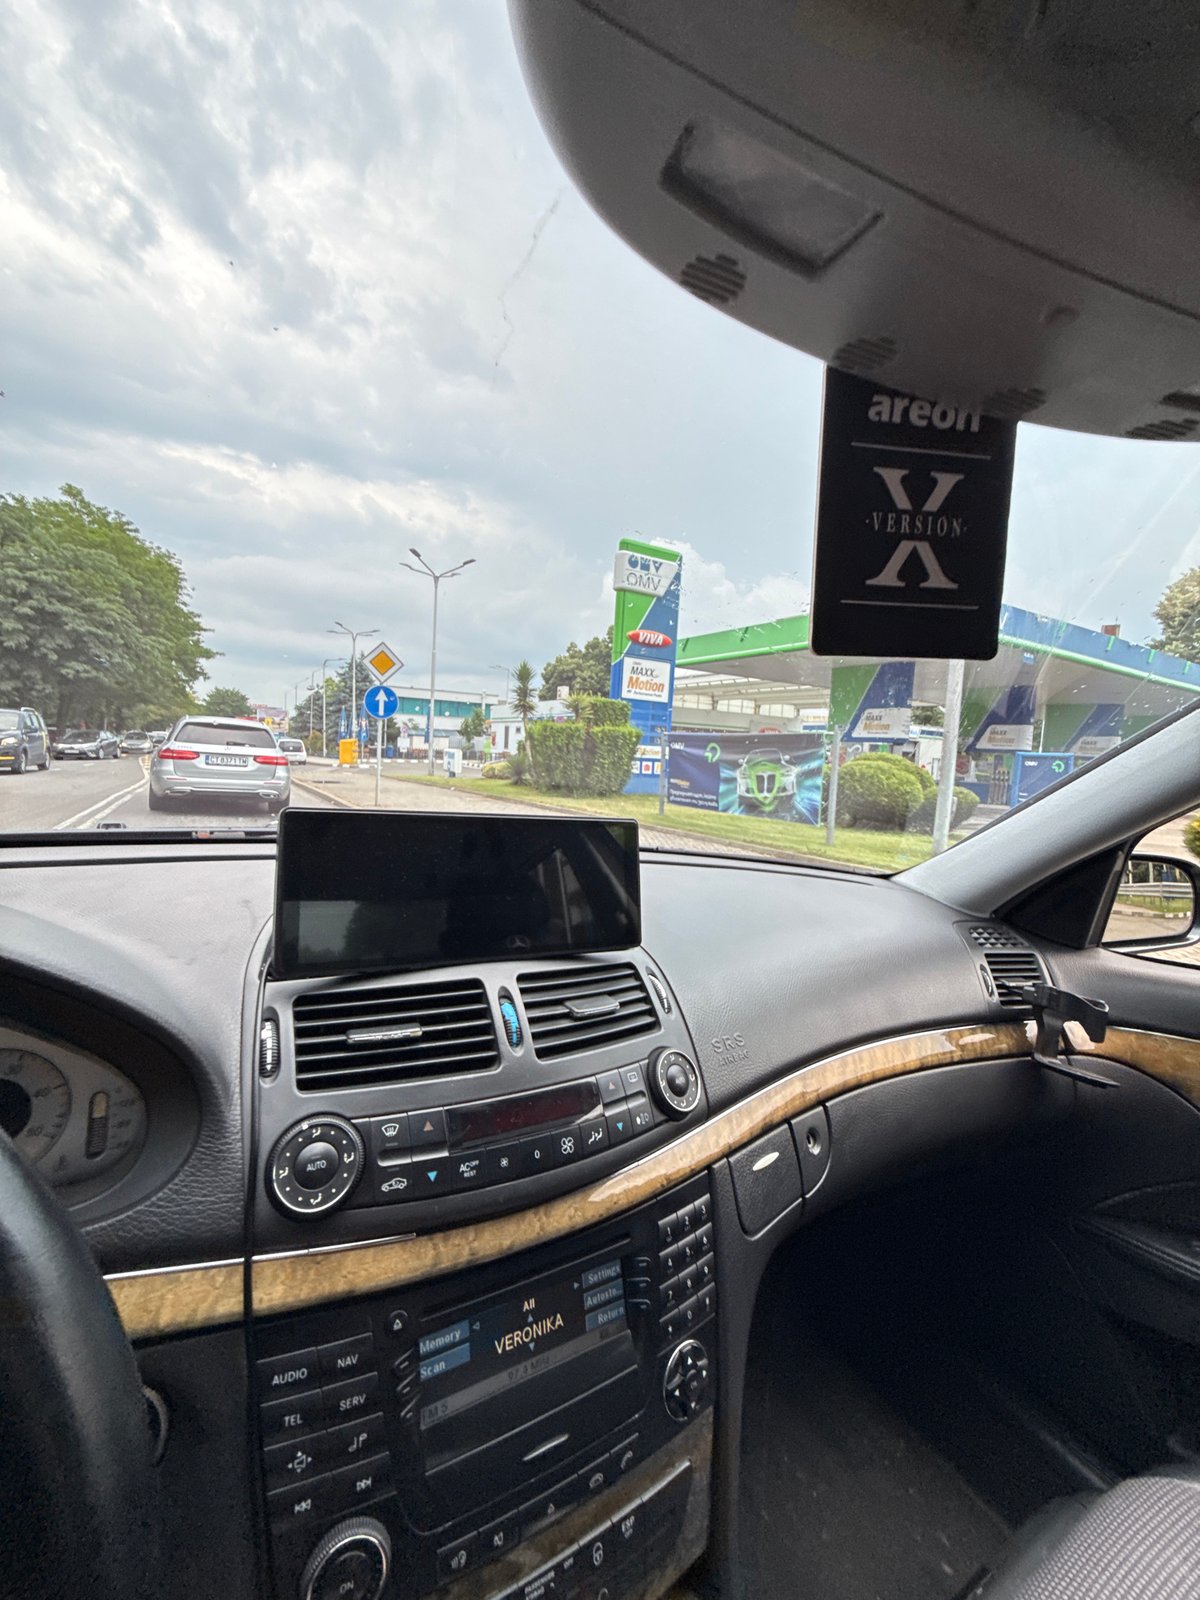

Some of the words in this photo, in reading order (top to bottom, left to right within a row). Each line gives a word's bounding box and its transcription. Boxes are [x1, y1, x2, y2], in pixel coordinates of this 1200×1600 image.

[867, 393, 981, 433] areon
[871, 511, 963, 537] VERSION
[626, 572, 661, 591] OMV
[638, 631, 664, 646] VIVA
[630, 665, 655, 678] MAXX
[627, 676, 665, 693] Motion
[711, 1032, 745, 1054] SRS
[306, 1160, 327, 1172] AUTO
[588, 1264, 621, 1284] Settings
[523, 1297, 535, 1313] All
[598, 1306, 624, 1325] Return
[420, 1329, 461, 1353] Memory
[494, 1313, 564, 1355] VERONIKA
[337, 1353, 359, 1369] NAV
[420, 1360, 446, 1379] Scan
[272, 1367, 308, 1387] AUDIO
[339, 1393, 367, 1412] SERV
[284, 1413, 304, 1428] TEL
[621, 1515, 635, 1533] ESP
[340, 1580, 354, 1595] ON
